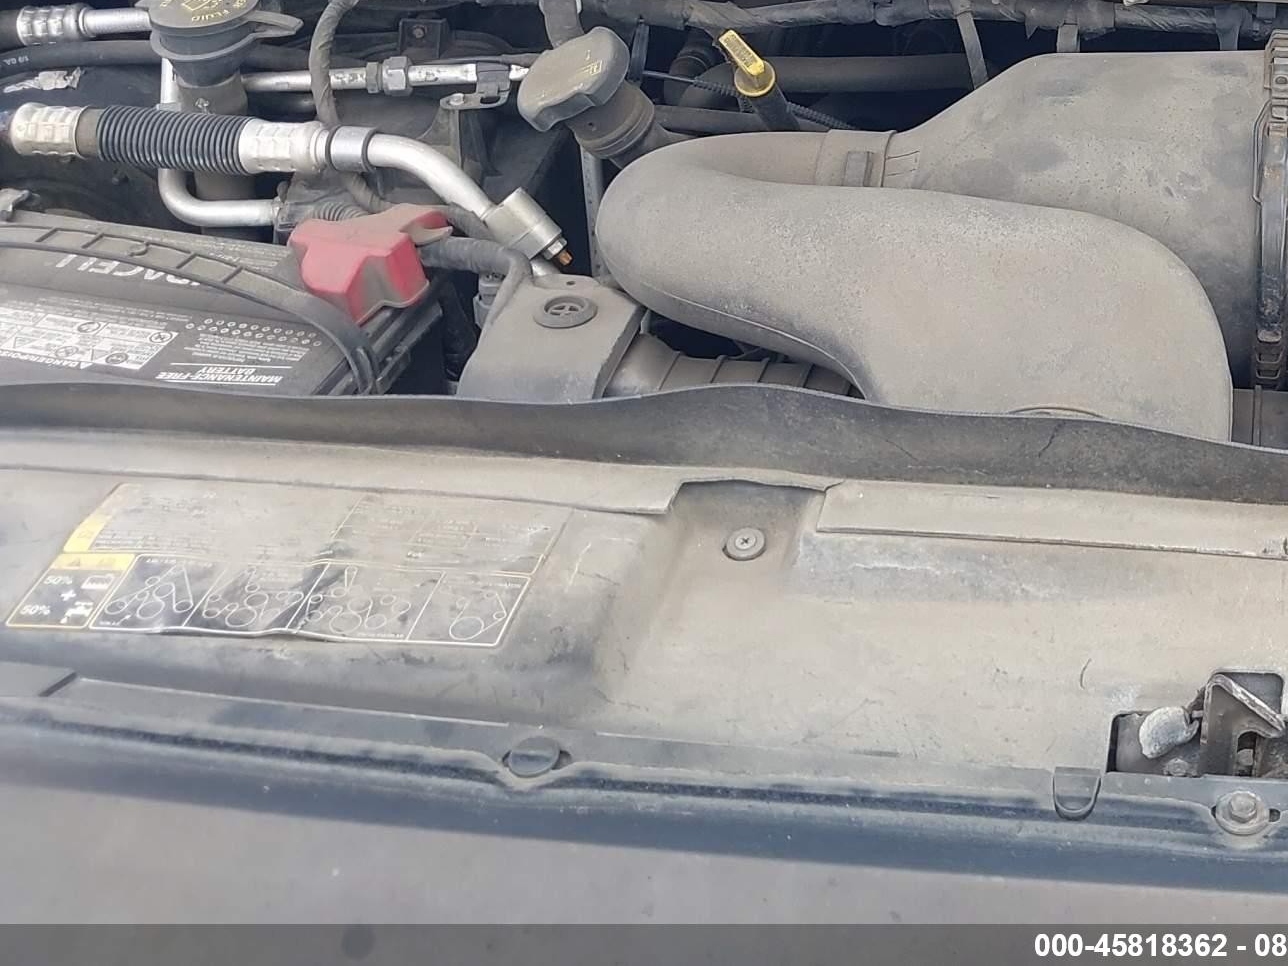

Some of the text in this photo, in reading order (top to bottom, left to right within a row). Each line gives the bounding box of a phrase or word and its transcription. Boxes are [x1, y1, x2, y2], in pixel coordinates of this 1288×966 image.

[190, 9, 231, 22] FLUID
[196, 366, 256, 376] BATTERY
[154, 371, 283, 384] MAINTENANCE-FREE
[44, 575, 73, 585] 50%
[20, 604, 51, 616] 50%
